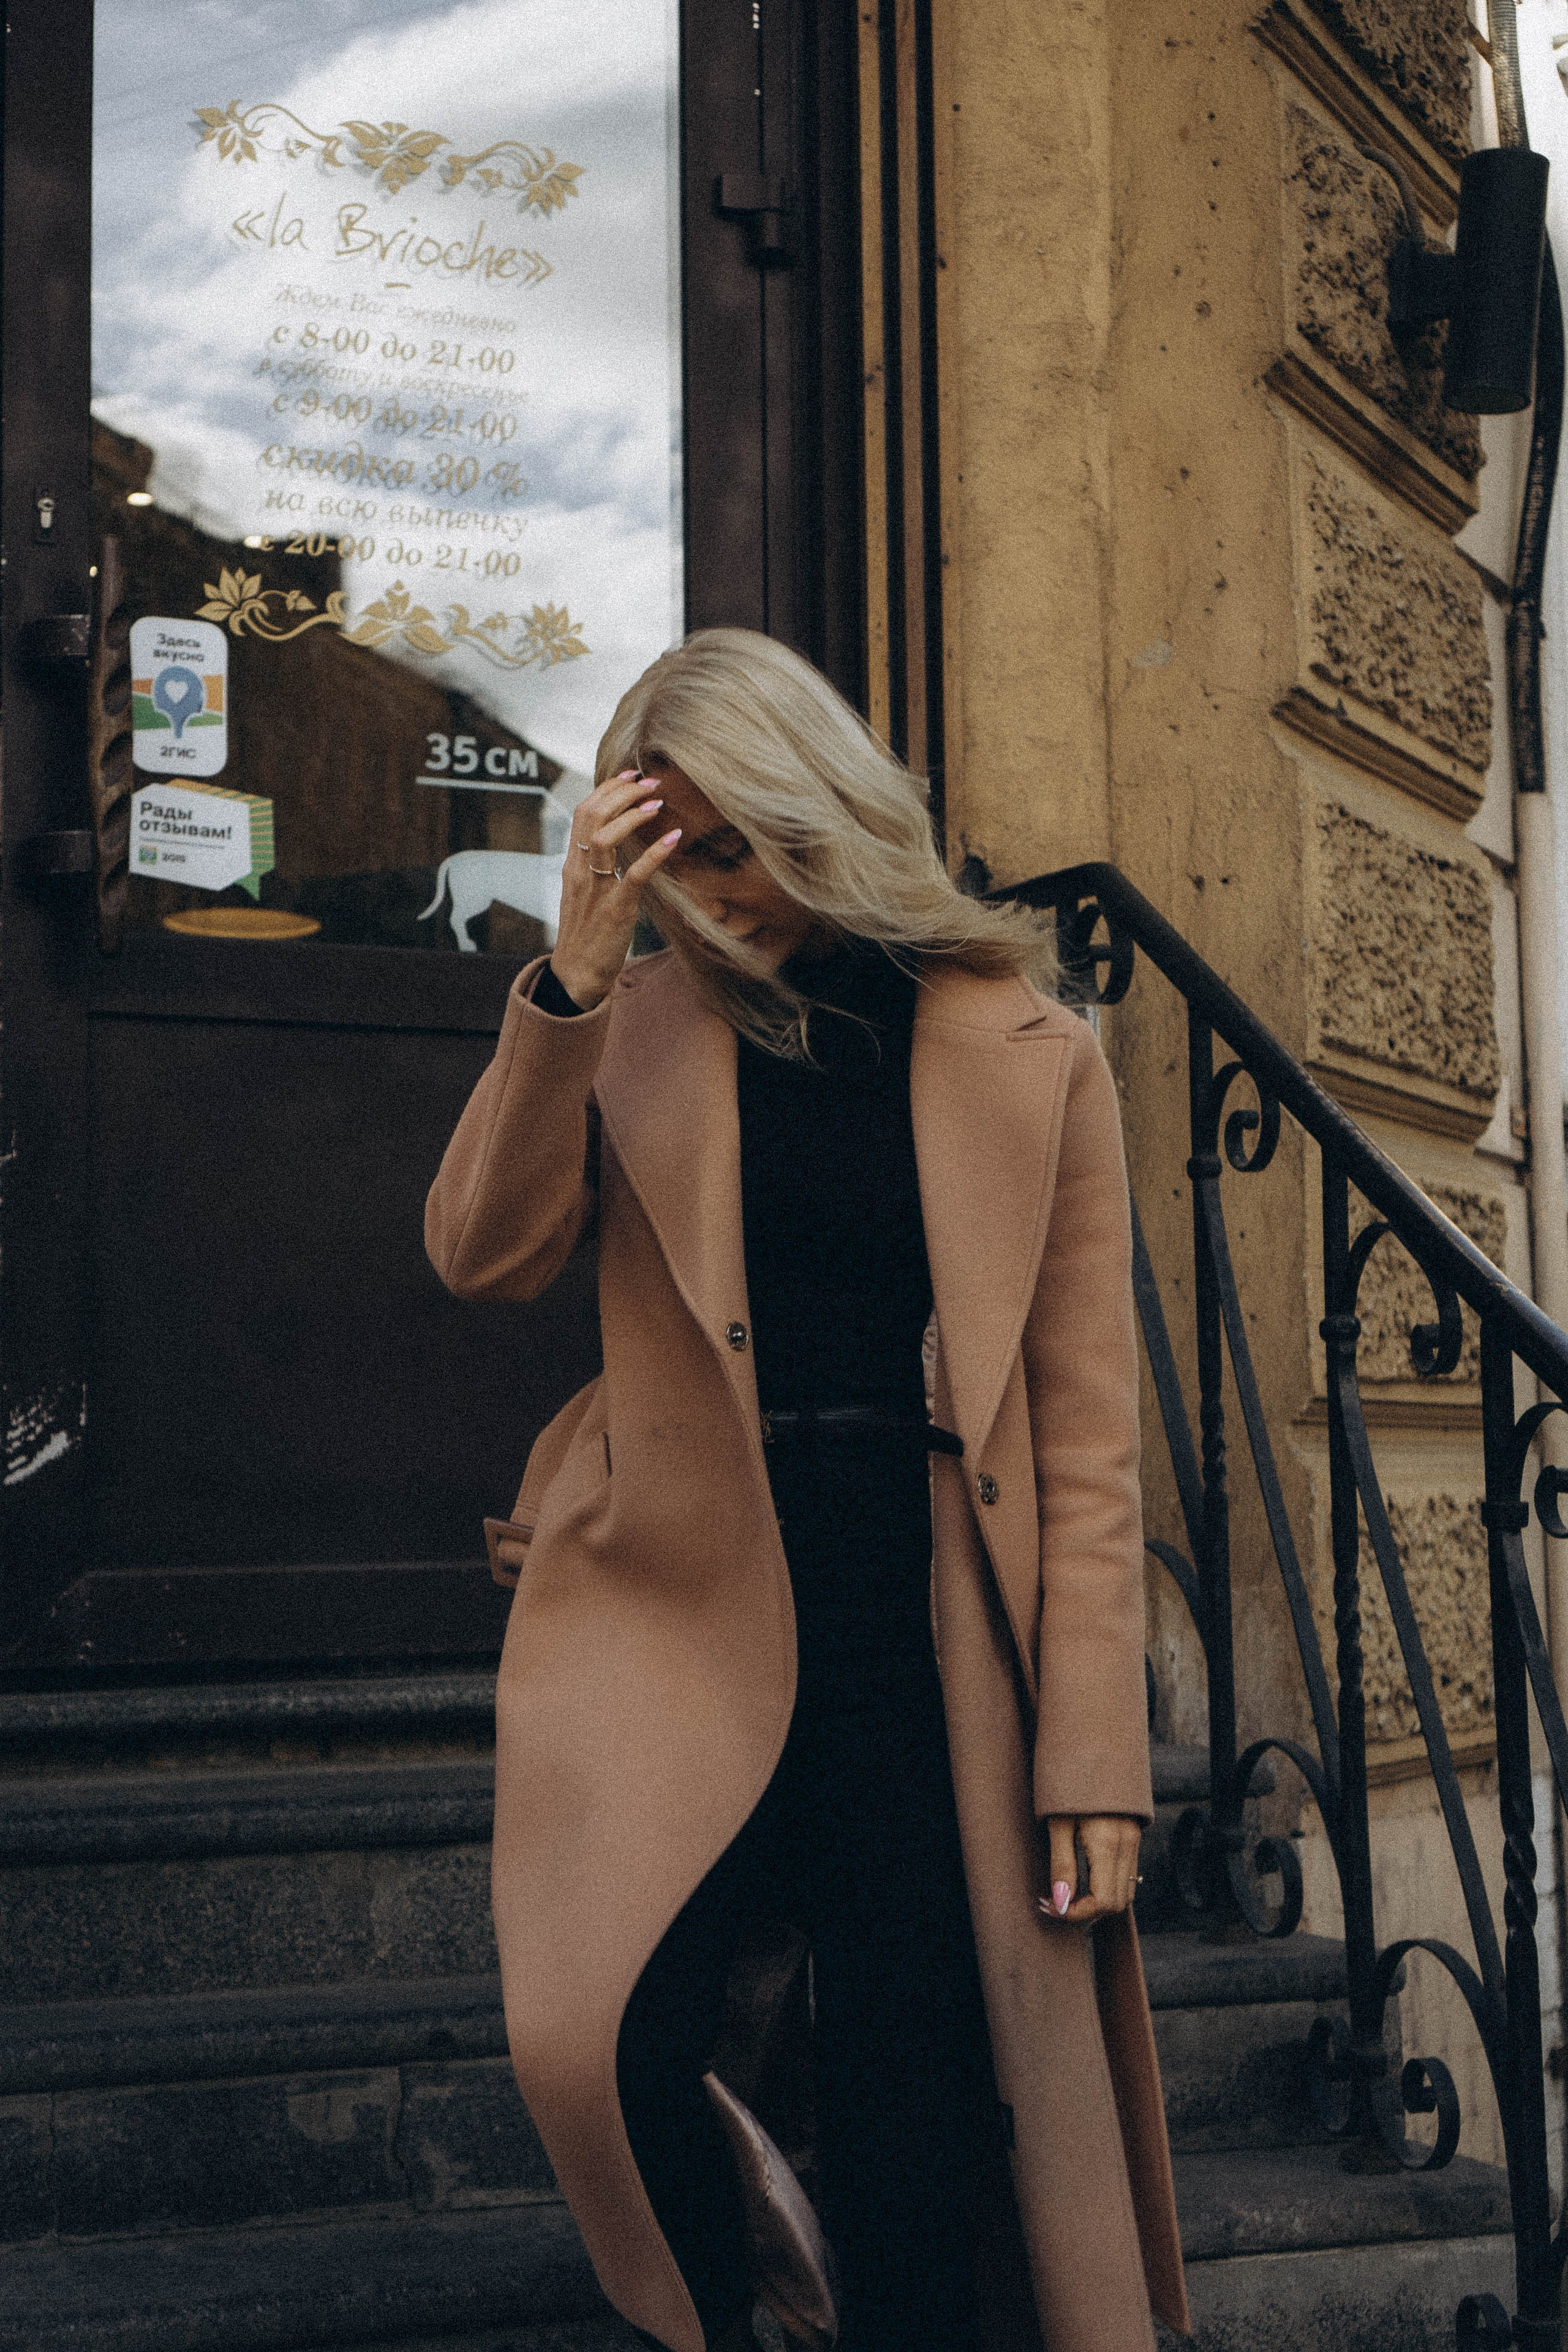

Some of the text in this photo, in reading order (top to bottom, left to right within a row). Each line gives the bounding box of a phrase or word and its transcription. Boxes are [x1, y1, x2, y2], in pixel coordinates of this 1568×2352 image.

[299, 322, 371, 355] 8-00
[381, 331, 417, 361] до
[300, 388, 372, 423] 9-00
[382, 398, 419, 429] до
[263, 490, 529, 542] на всю выпечку
[284, 530, 376, 561] 20-00
[386, 538, 423, 566] до
[157, 633, 201, 648] Здесь
[153, 649, 205, 662] вкусно
[159, 745, 197, 760] 2ГИС
[140, 801, 193, 821] Рады
[138, 819, 233, 840] отзывам!
